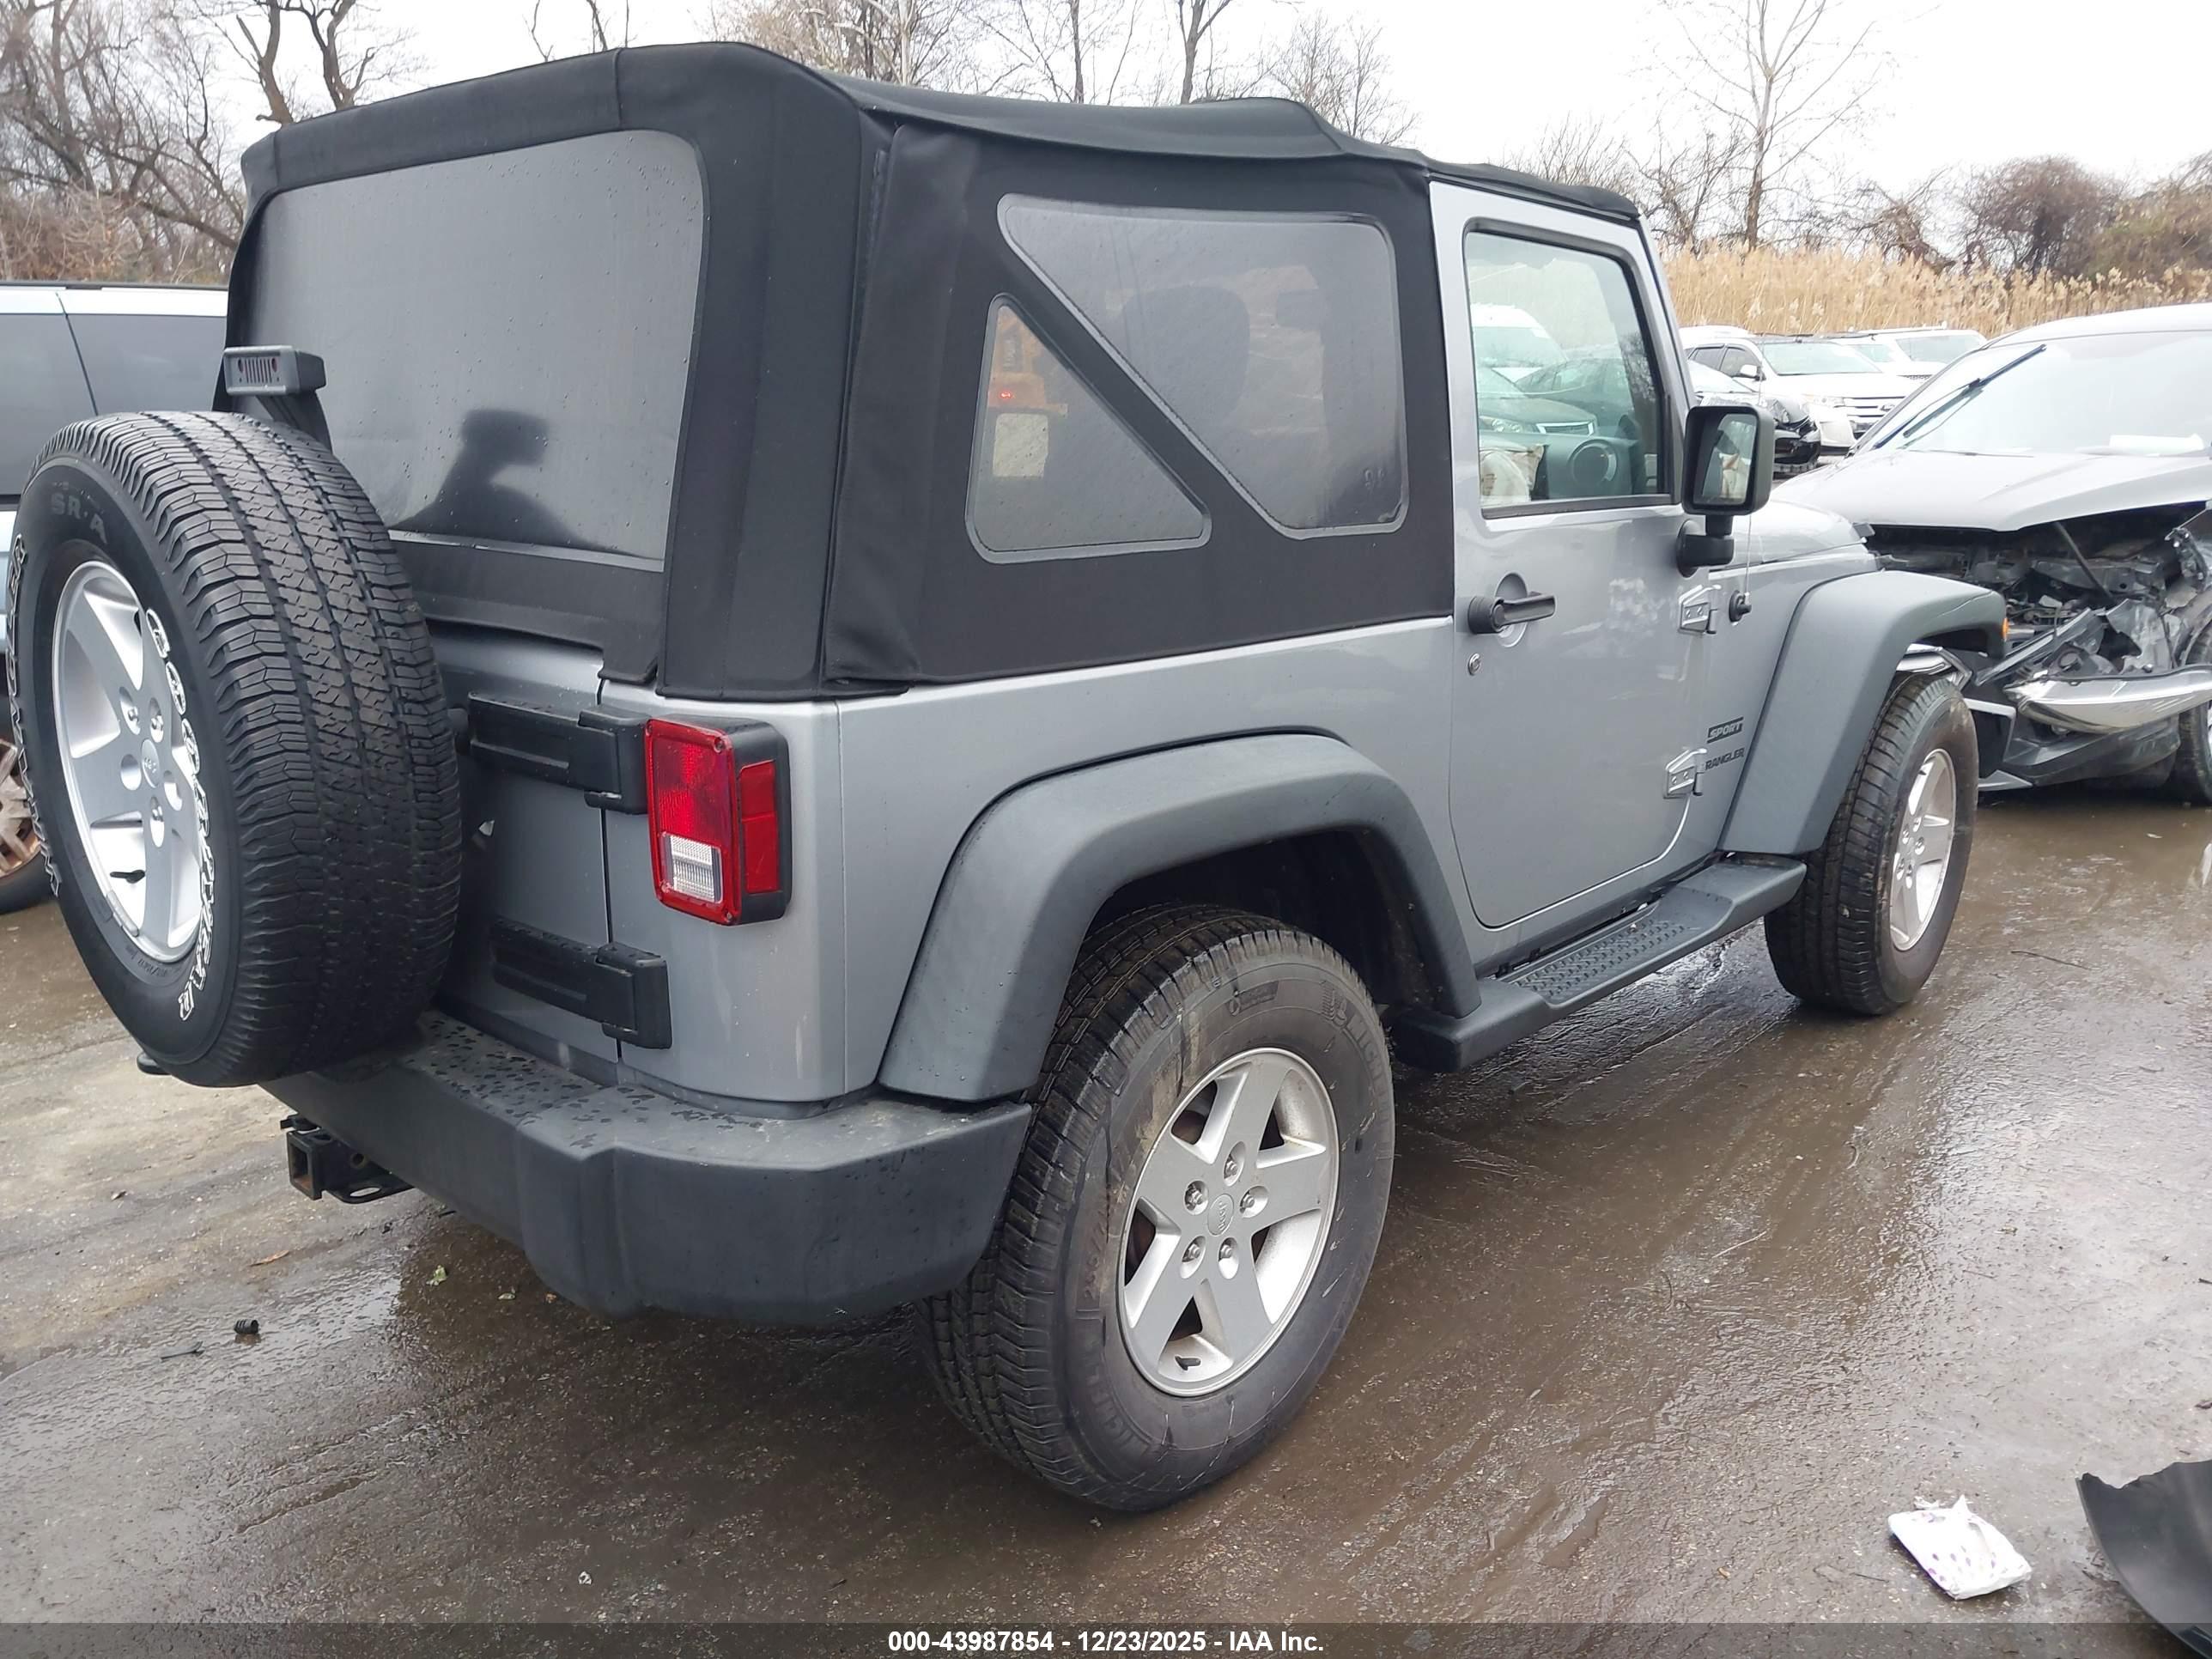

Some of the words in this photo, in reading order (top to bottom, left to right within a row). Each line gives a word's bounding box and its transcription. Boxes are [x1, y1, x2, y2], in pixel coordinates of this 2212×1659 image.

[1710, 722, 1741, 738] SPORT
[1705, 747, 1745, 770] RANGLER
[145, 607, 215, 1021] GOODYEAR
